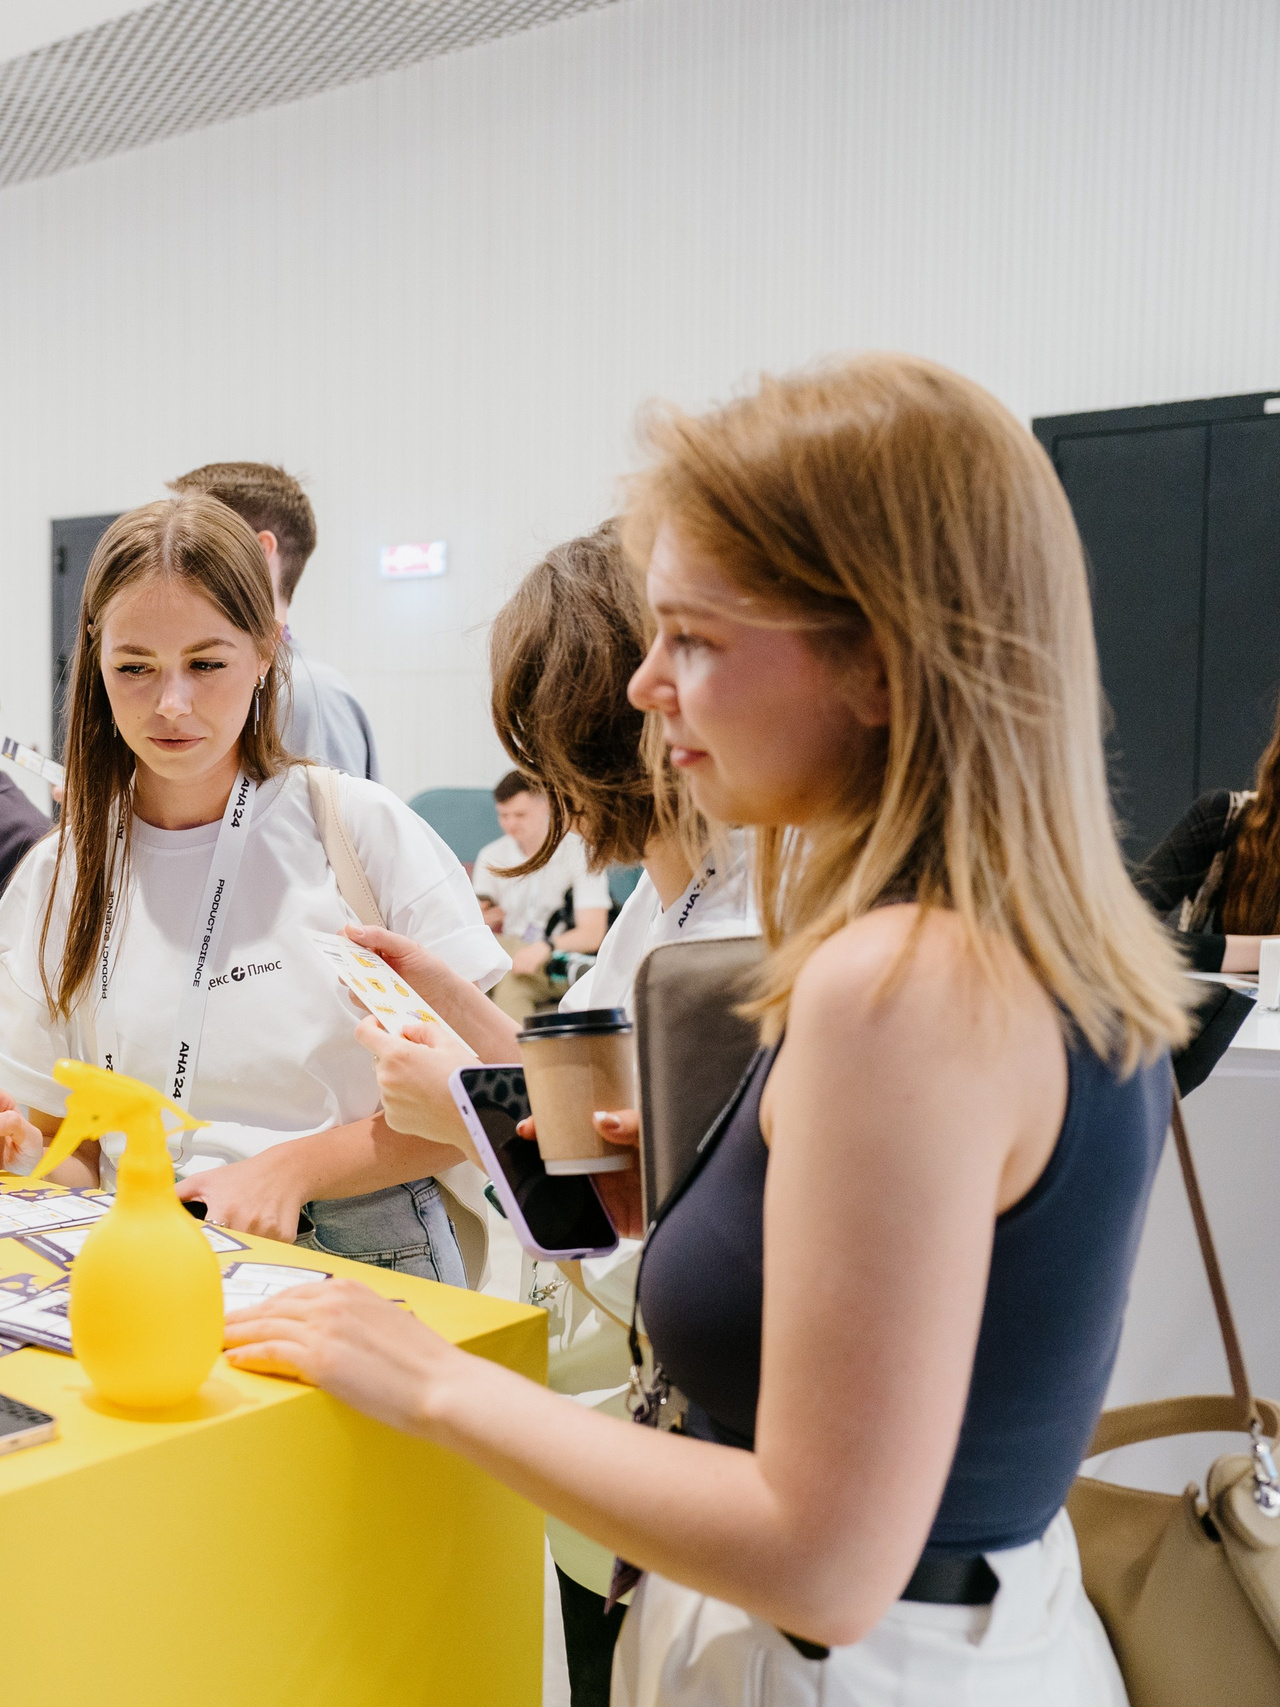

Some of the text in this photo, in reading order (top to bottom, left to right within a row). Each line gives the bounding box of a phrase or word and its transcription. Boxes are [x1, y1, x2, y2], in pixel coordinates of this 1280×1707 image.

[231, 776, 250, 828] AHA'24
[192, 878, 226, 988] PRODUCT SCIENCE
[101, 944, 110, 1000] PRODUCT
[208, 960, 283, 991] екс Плюс
[172, 1041, 190, 1099] AHA'24
